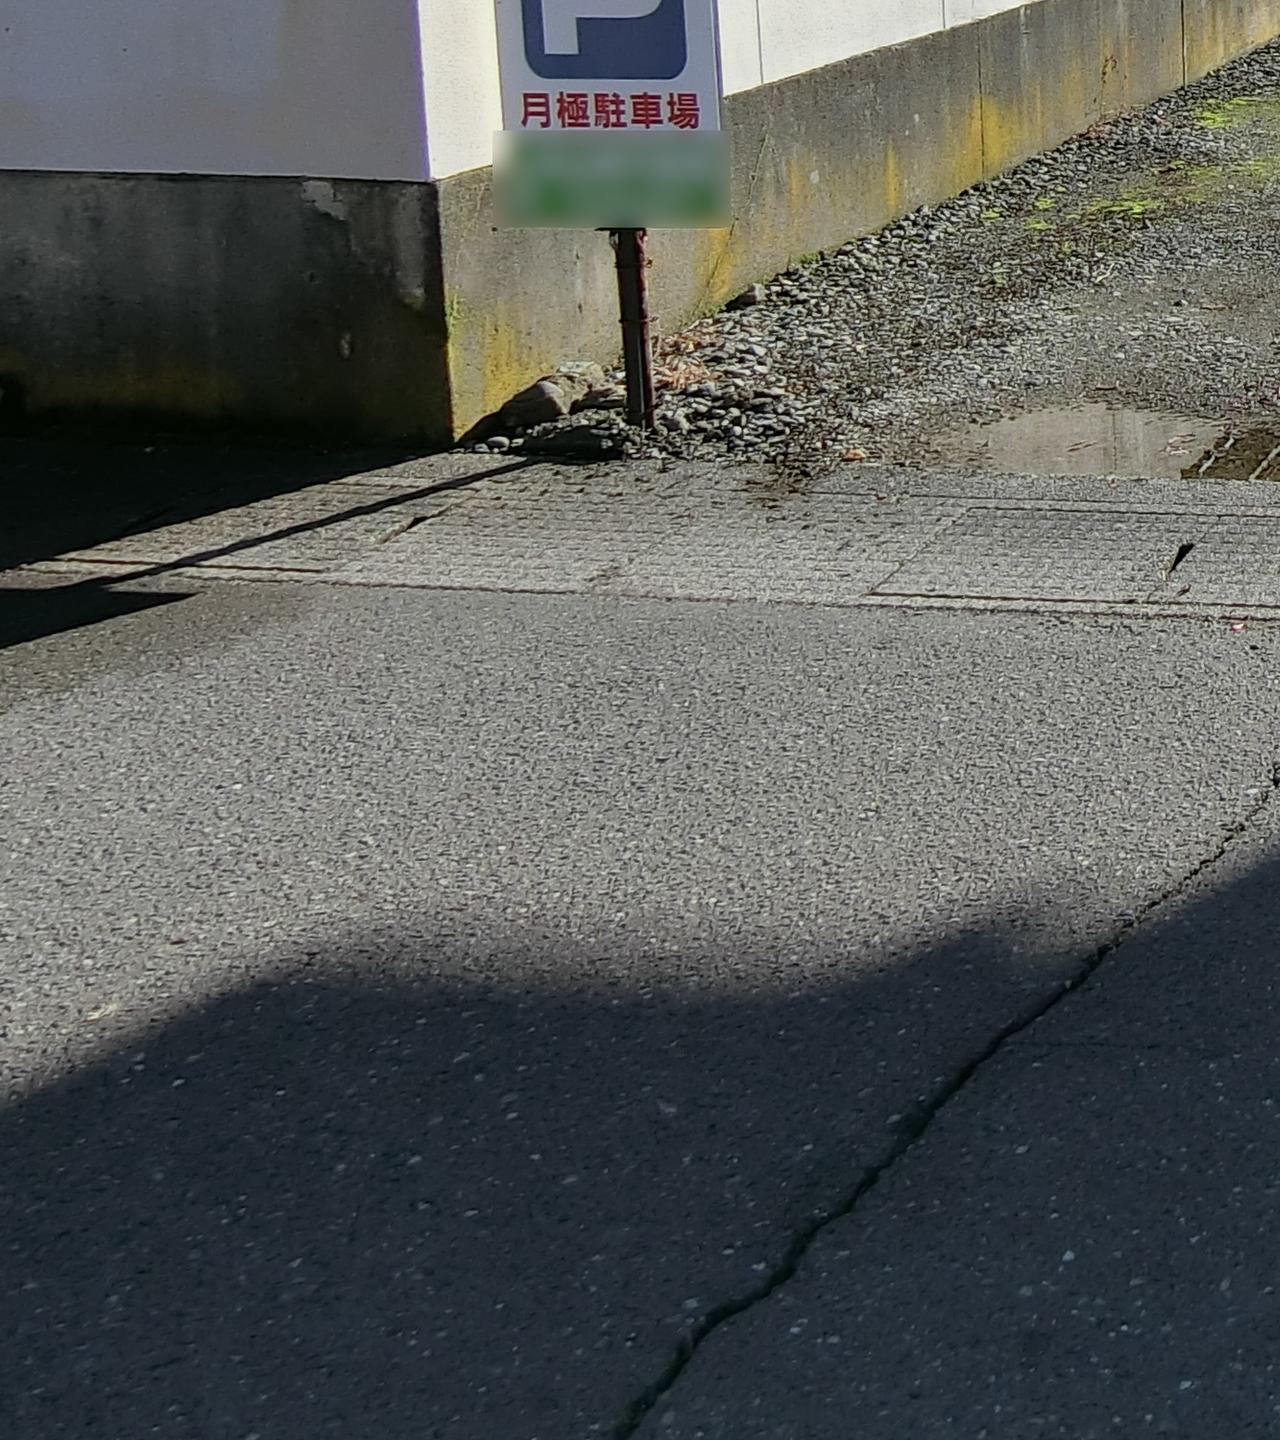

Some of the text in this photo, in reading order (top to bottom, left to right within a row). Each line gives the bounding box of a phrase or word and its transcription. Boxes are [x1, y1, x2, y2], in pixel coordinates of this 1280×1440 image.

[520, 91, 701, 130] 月極駐車場
